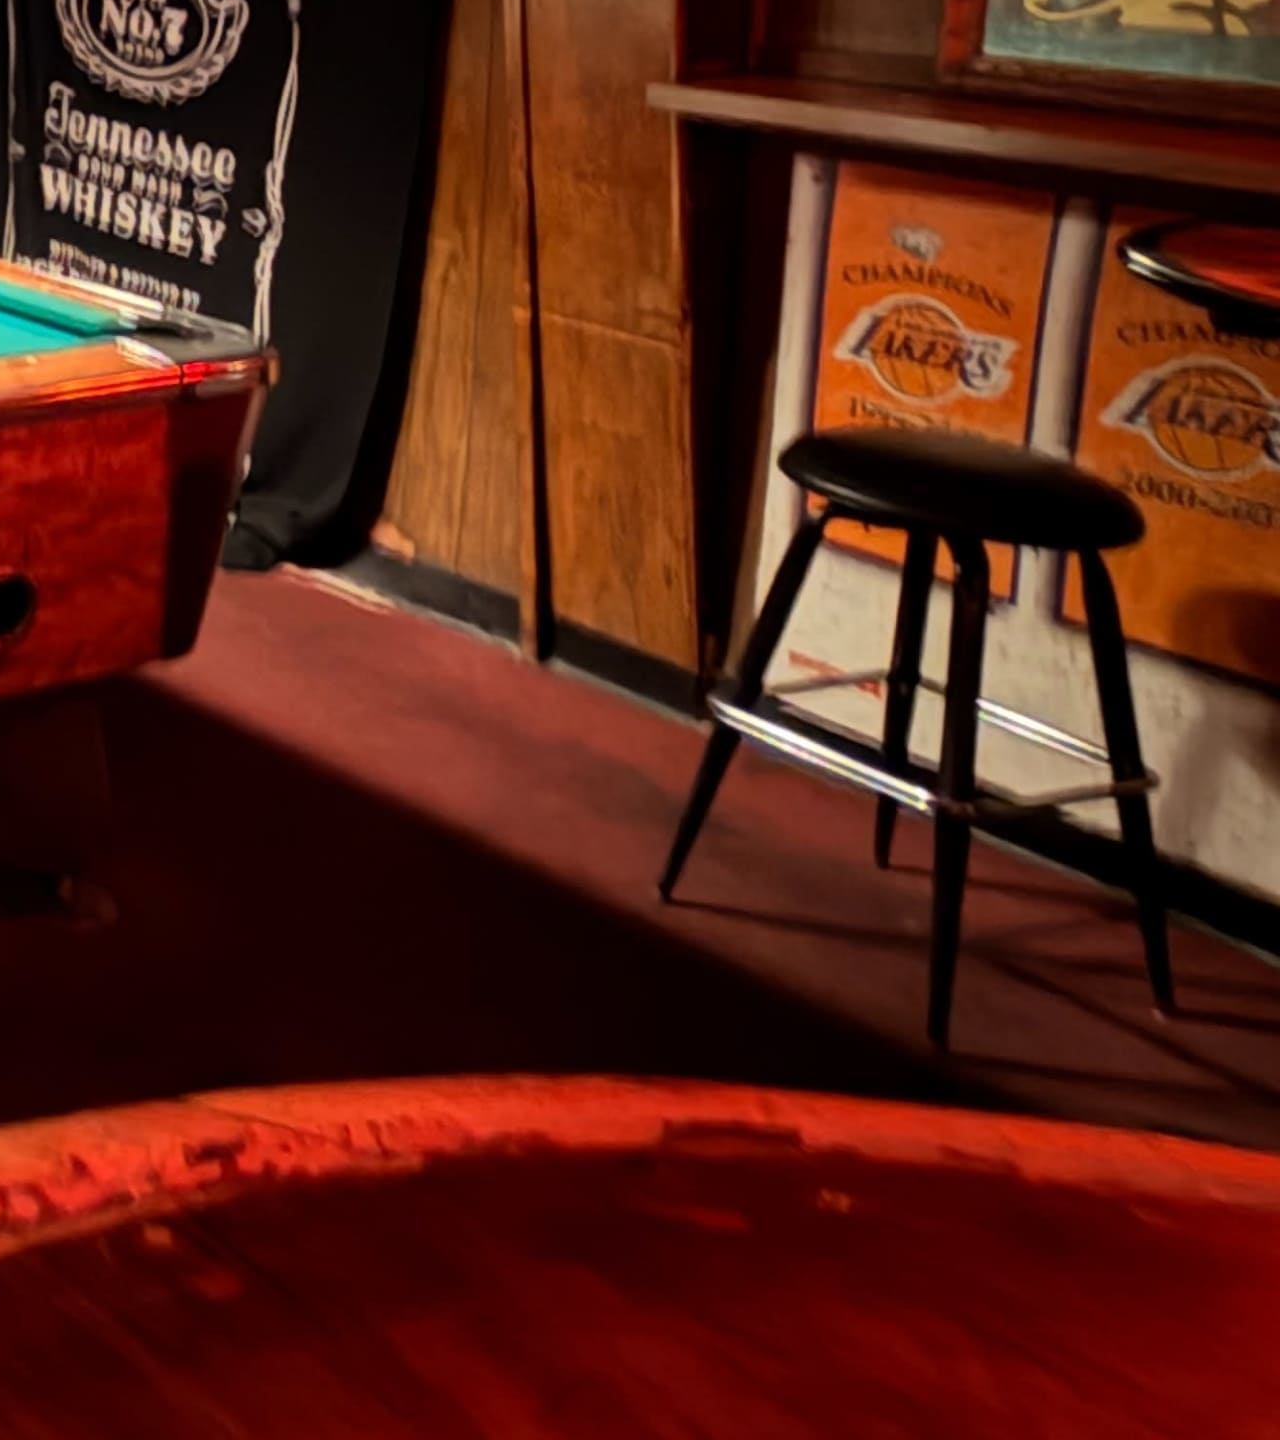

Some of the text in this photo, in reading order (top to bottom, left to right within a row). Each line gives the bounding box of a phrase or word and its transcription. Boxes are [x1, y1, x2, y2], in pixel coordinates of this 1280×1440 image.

[43, 79, 237, 192] Tennessee
[40, 162, 227, 265] WHISKEY
[842, 264, 1014, 320] CHAMPIONS
[850, 313, 997, 392] LAKERS
